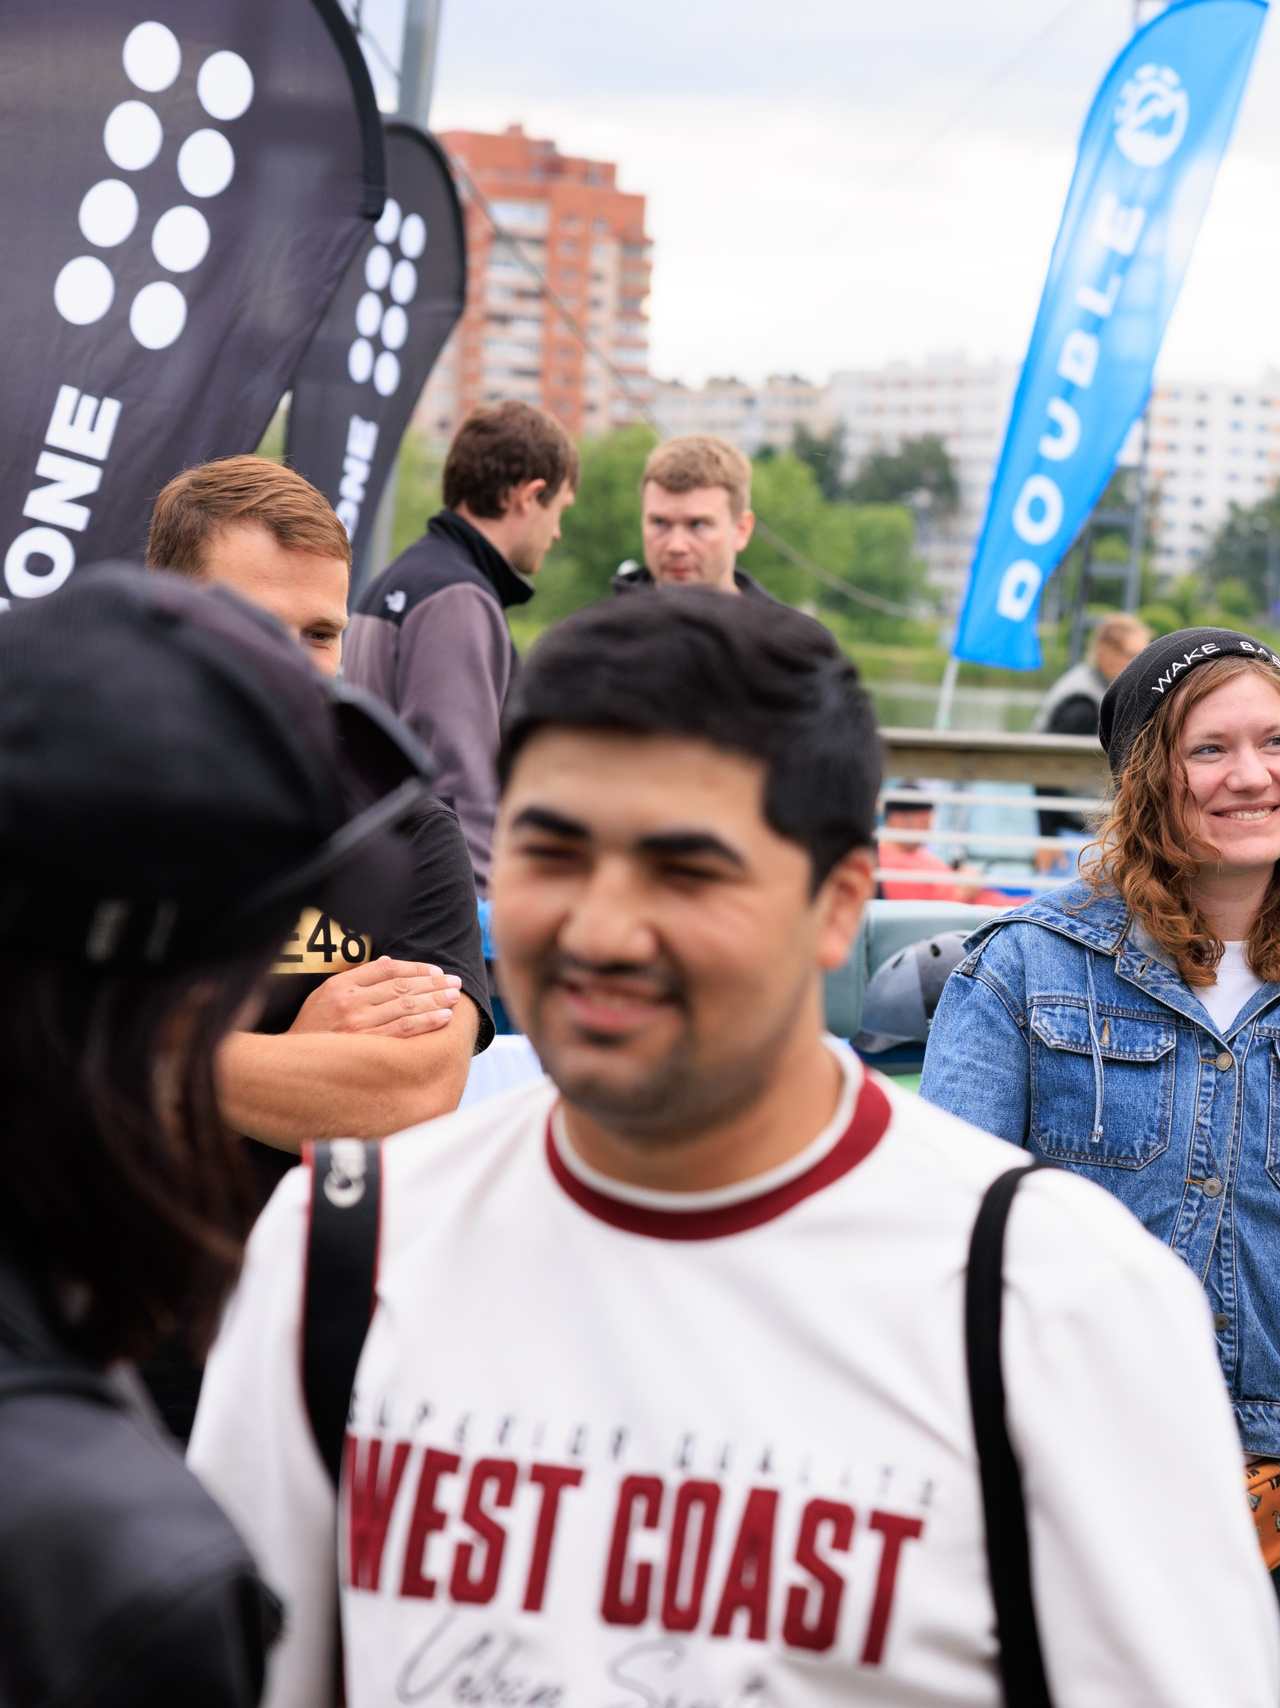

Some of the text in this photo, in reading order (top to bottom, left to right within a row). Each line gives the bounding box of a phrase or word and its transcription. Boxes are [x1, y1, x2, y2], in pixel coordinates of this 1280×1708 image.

[997, 192, 1146, 622] DOUBLE
[1152, 642, 1221, 693] WAKE
[346, 1434, 584, 1613] WEST
[602, 1474, 925, 1667] COAST
